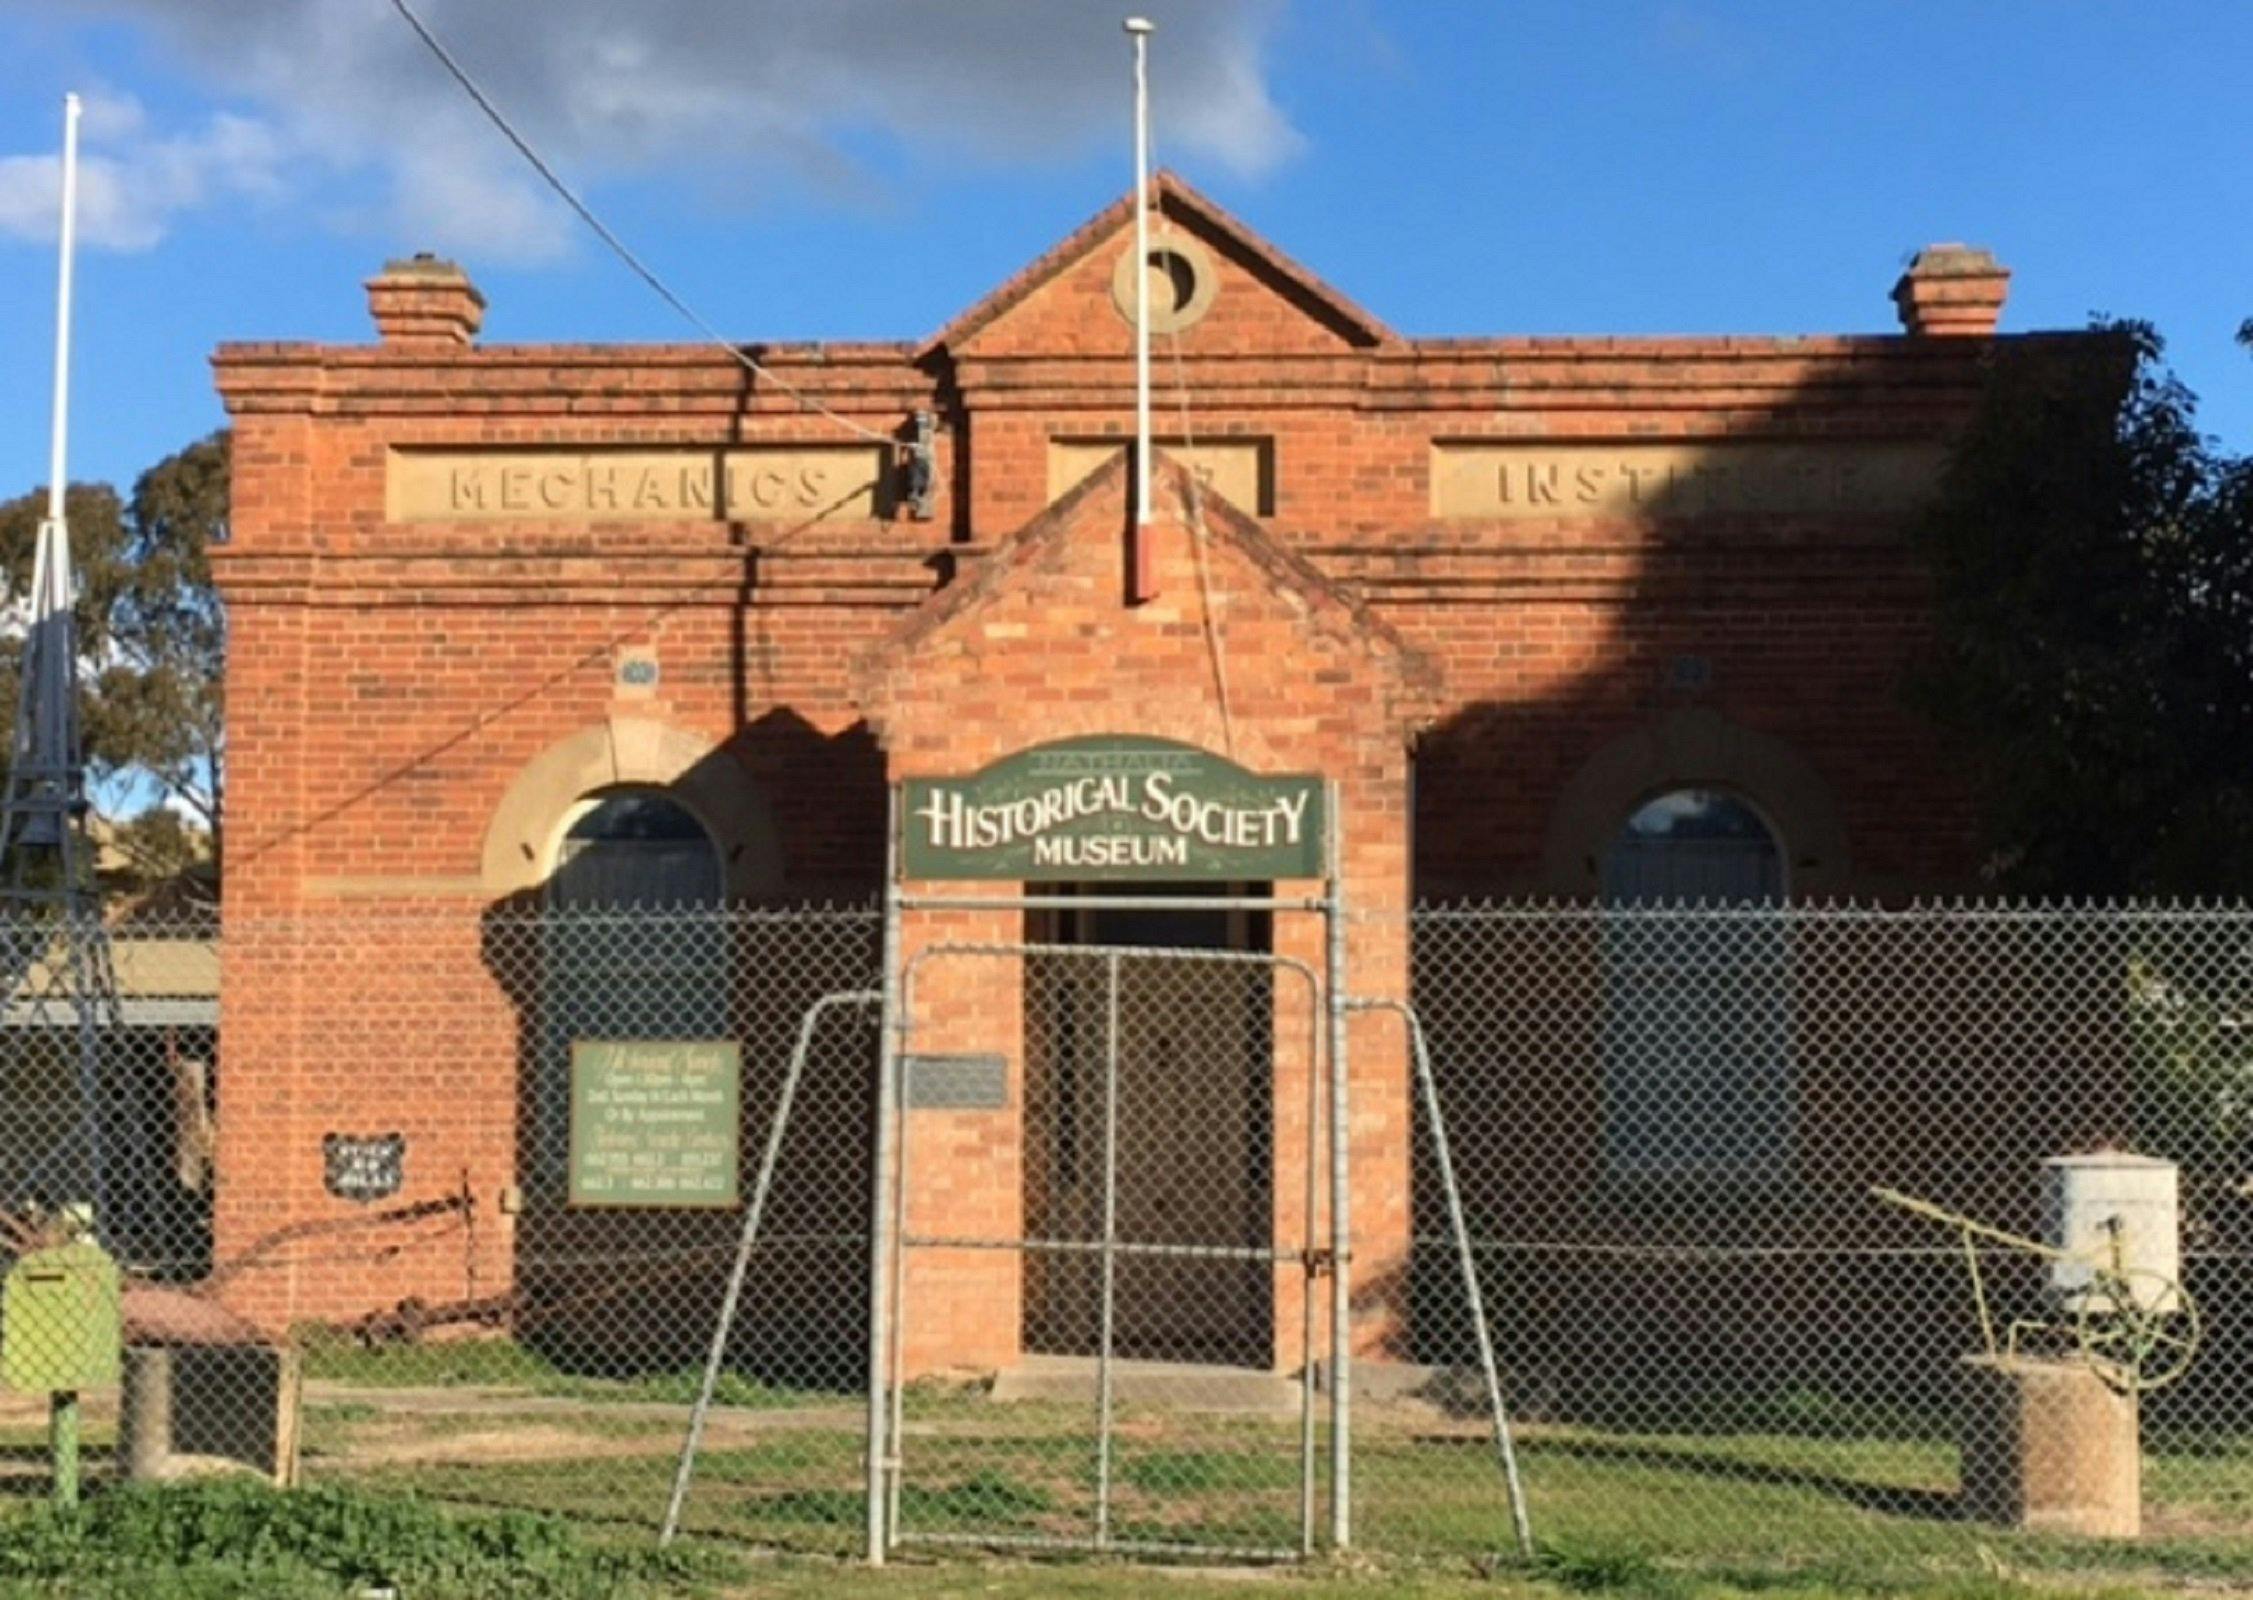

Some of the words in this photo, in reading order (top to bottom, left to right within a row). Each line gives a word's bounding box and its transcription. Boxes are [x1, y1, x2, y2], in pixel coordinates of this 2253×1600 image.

[449, 465, 828, 512] MECHANICS
[914, 775, 1136, 848] HISTORICAL
[1141, 770, 1308, 847] SOCIETY
[1034, 834, 1187, 866] MUSEUM
